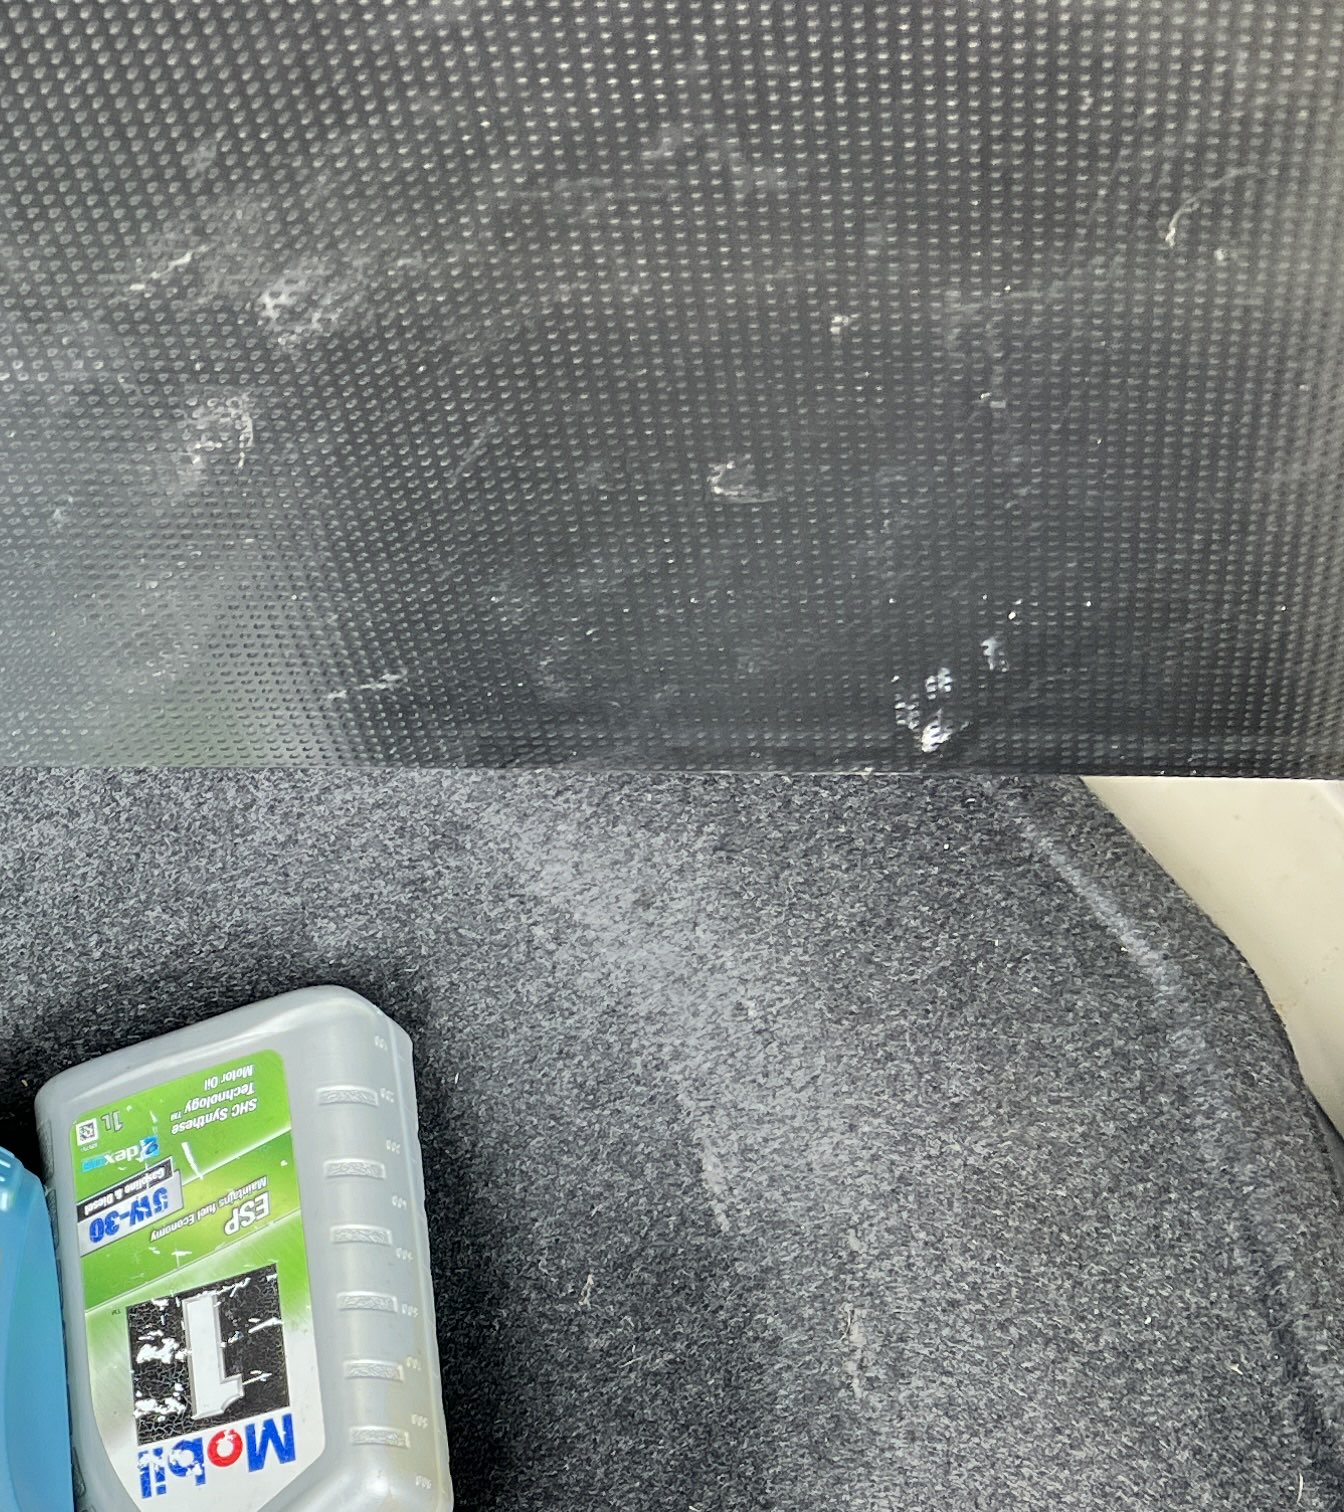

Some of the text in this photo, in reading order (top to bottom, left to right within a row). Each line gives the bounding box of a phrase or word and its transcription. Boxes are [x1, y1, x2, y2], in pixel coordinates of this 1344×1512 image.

[204, 1064, 254, 1091] Motor Oil
[171, 1098, 257, 1135] SHC Synthese
[184, 1082, 255, 1114] Technology
[101, 1110, 123, 1132] 1L
[84, 1195, 114, 1216] Diesel
[115, 1189, 124, 1200] &
[149, 1175, 267, 1243] Maintains fuel Economy
[89, 1187, 169, 1243] 5W-30
[224, 1191, 270, 1236] ESP
[181, 1291, 245, 1420] 1
[137, 1413, 297, 1499] Mobil
